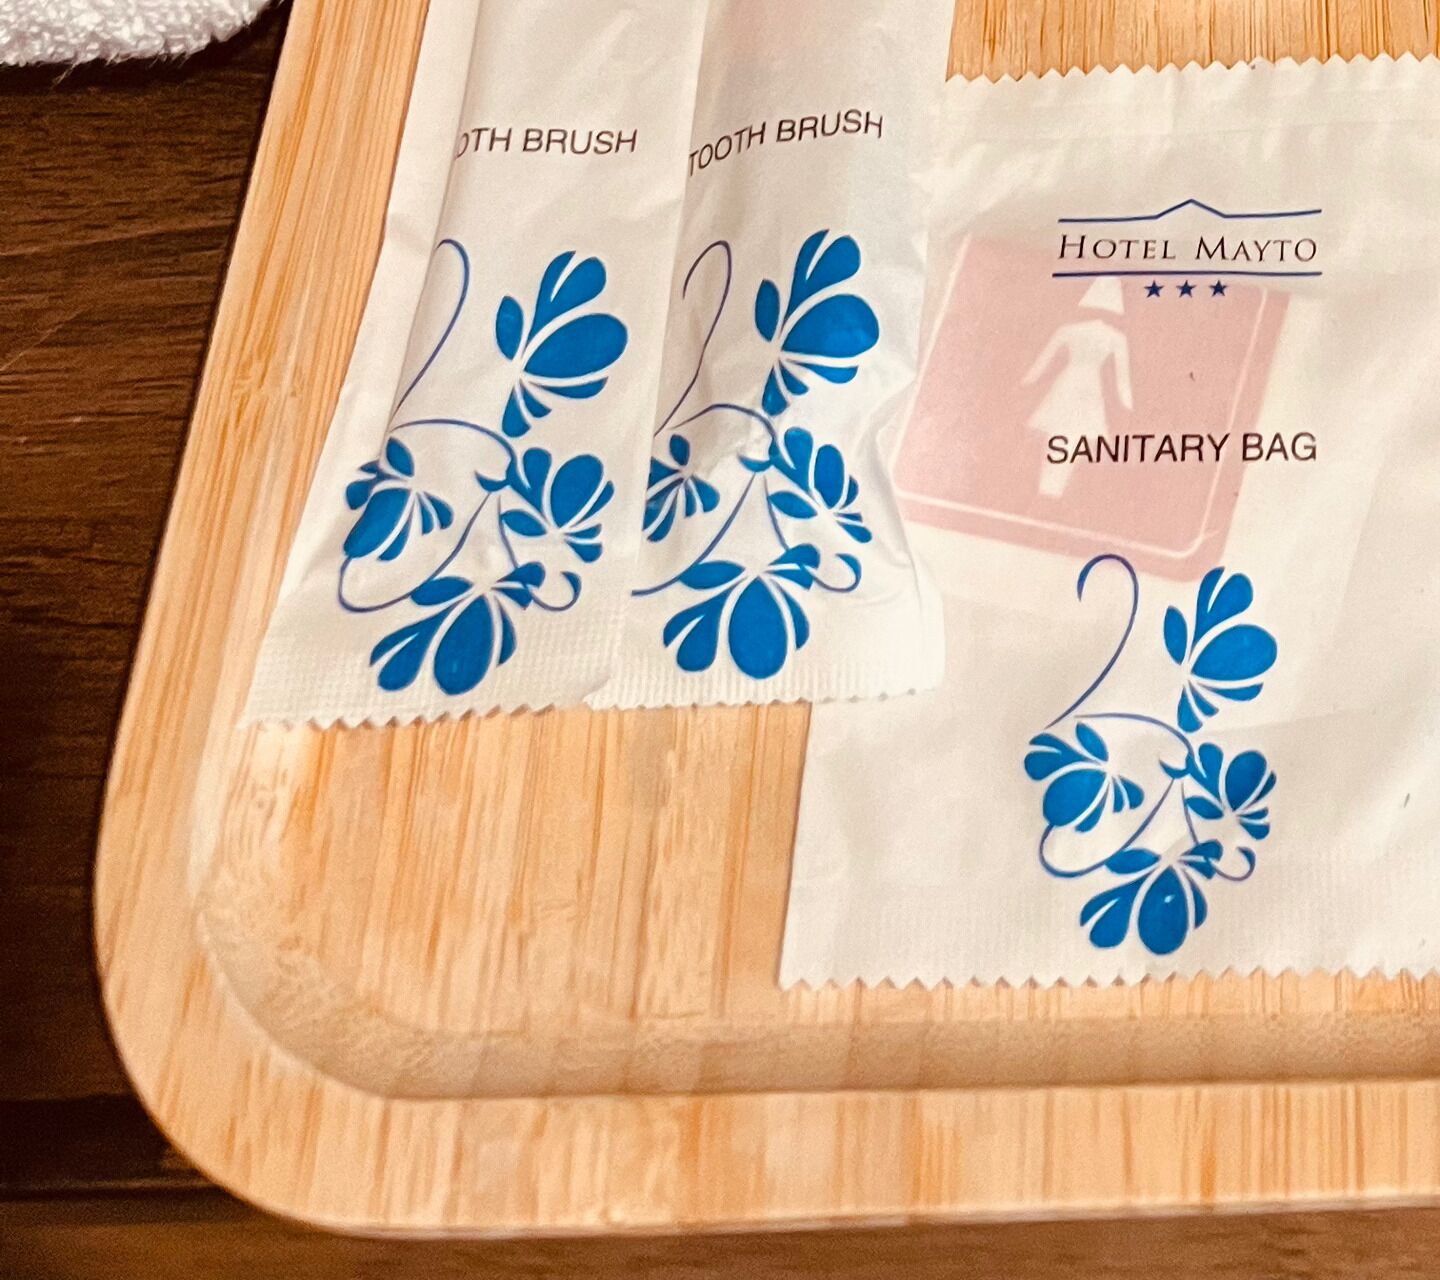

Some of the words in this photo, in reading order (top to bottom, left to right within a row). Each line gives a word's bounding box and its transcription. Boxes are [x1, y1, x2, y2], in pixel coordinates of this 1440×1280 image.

[522, 127, 638, 155] BRUSH
[688, 121, 767, 177] TOOTH
[775, 108, 883, 143] BRUSH
[1057, 234, 1176, 261] HOTEL
[1194, 235, 1318, 263] MAYTO
[1046, 433, 1231, 465] SANITARY
[1241, 432, 1318, 462] BAG
